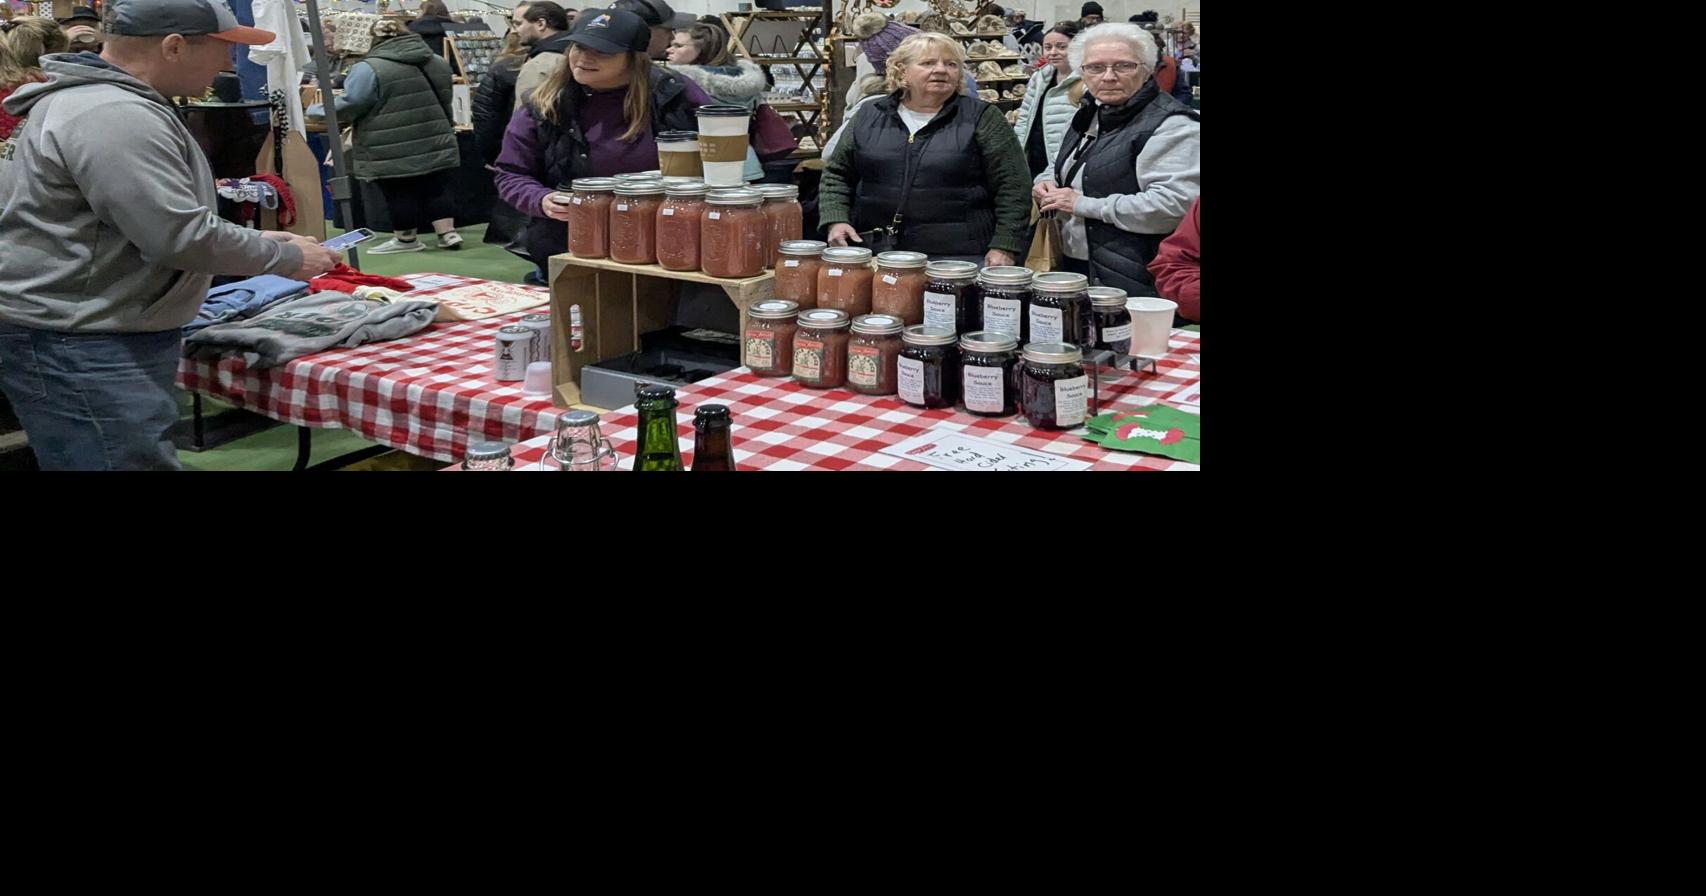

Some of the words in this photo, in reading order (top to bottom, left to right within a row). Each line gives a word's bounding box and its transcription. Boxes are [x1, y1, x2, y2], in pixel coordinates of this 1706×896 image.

[986, 303, 1016, 313] Blueberry
[1031, 310, 1058, 320] Blueberry
[967, 371, 1000, 380] Blueberry
[1060, 384, 1087, 393] Blueberry
[928, 446, 971, 458] Free
